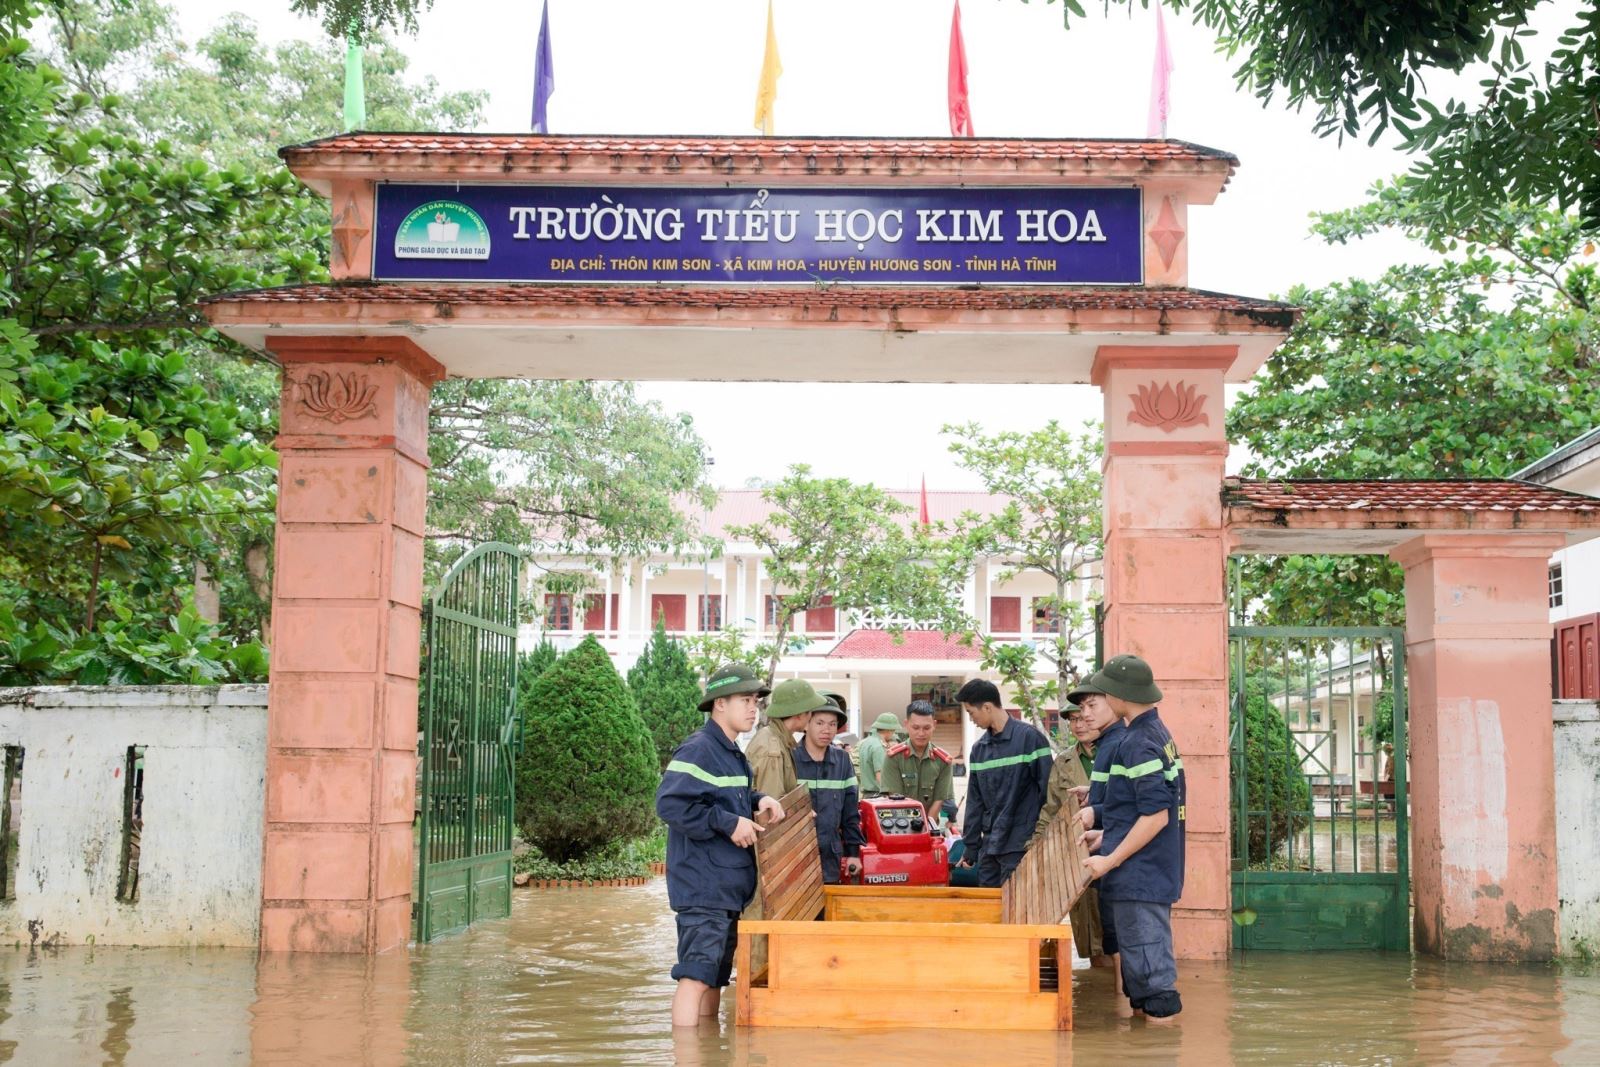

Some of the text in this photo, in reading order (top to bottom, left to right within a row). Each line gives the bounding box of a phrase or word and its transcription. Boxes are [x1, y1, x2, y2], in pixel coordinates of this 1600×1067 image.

[509, 188, 1107, 251] TRƯỜNG TIỂU HỌC KIM HOA
[551, 258, 576, 273] ĐỊA
[579, 254, 606, 271] CHỈ:
[610, 256, 648, 271] THÔN
[652, 258, 678, 271] KIM
[682, 258, 711, 271] SƠN
[723, 256, 744, 271] XÃ
[747, 259, 773, 271] KIM
[776, 259, 807, 271] HOA
[818, 256, 866, 274] HUYỆN
[869, 258, 919, 272] HƯƠNG
[923, 258, 952, 272] SƠN
[965, 255, 997, 272] TỈNH
[1001, 256, 1021, 271] HÀ
[1024, 256, 1057, 272] TĨNH
[868, 874, 907, 883] TOHATSU
